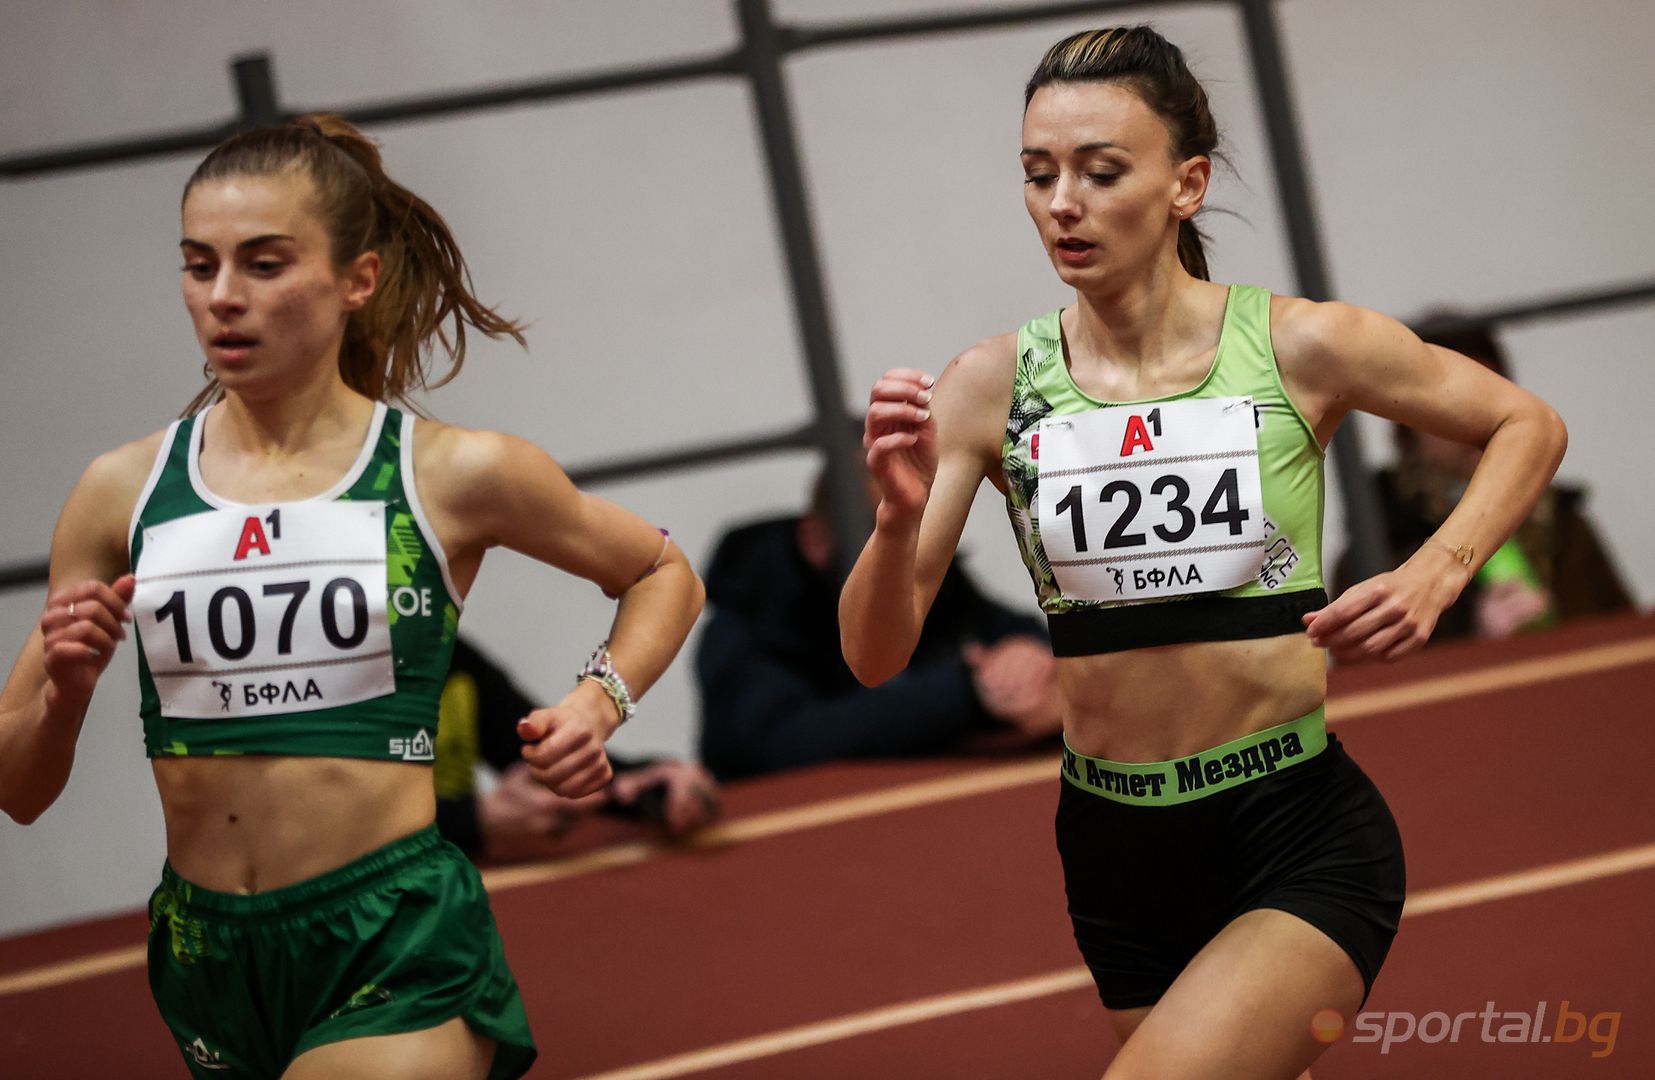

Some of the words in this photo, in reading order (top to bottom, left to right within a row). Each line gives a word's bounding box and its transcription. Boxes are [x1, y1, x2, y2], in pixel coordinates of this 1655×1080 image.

[1119, 407, 1162, 457] A1
[233, 508, 281, 561] A1
[1055, 468, 1250, 553] 1234
[1133, 563, 1203, 590] БФЛА
[154, 577, 370, 664] 1070
[243, 678, 323, 707] БФЛА
[1085, 758, 1167, 798] Атлет
[1174, 731, 1304, 794] Мездра
